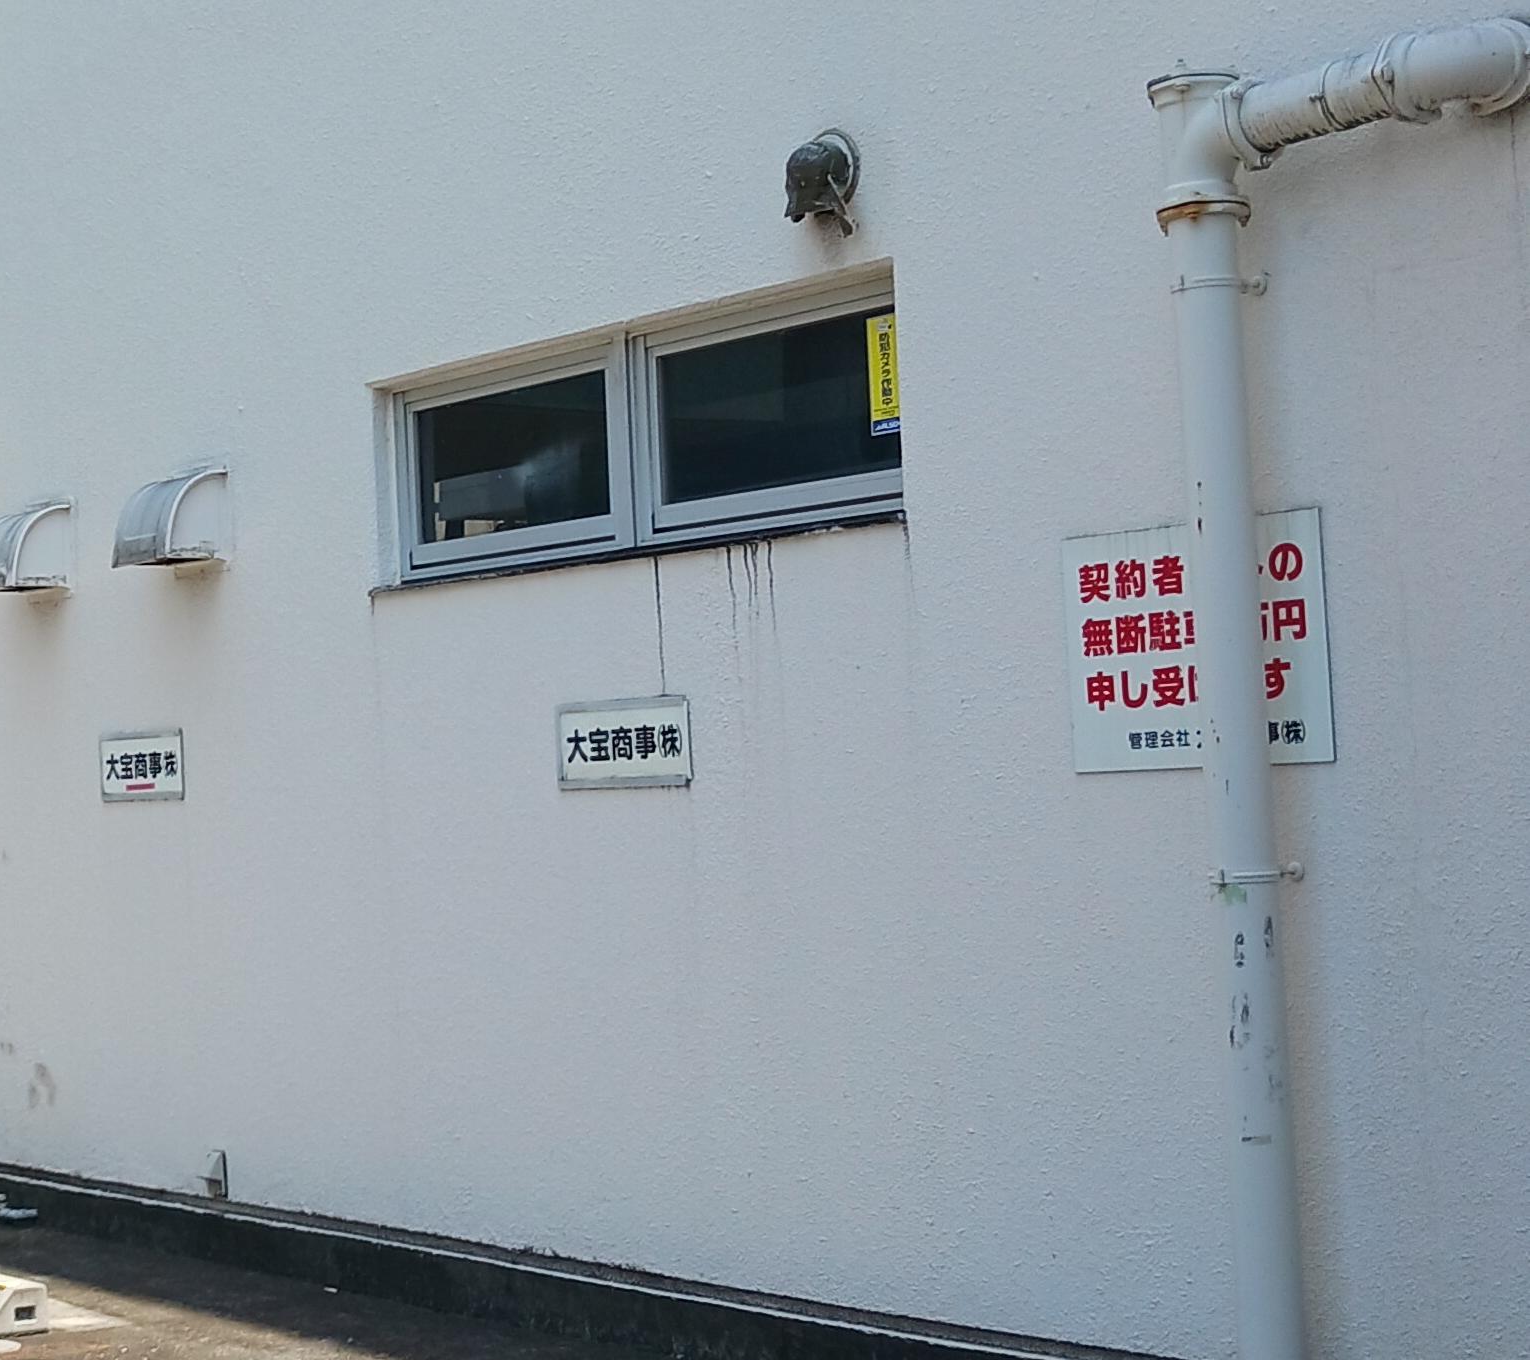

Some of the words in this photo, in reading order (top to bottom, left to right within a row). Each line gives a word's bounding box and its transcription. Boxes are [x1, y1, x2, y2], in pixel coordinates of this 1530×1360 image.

[1078, 542, 1303, 603] 契約者の
[1086, 658, 1291, 713] 申し受す
